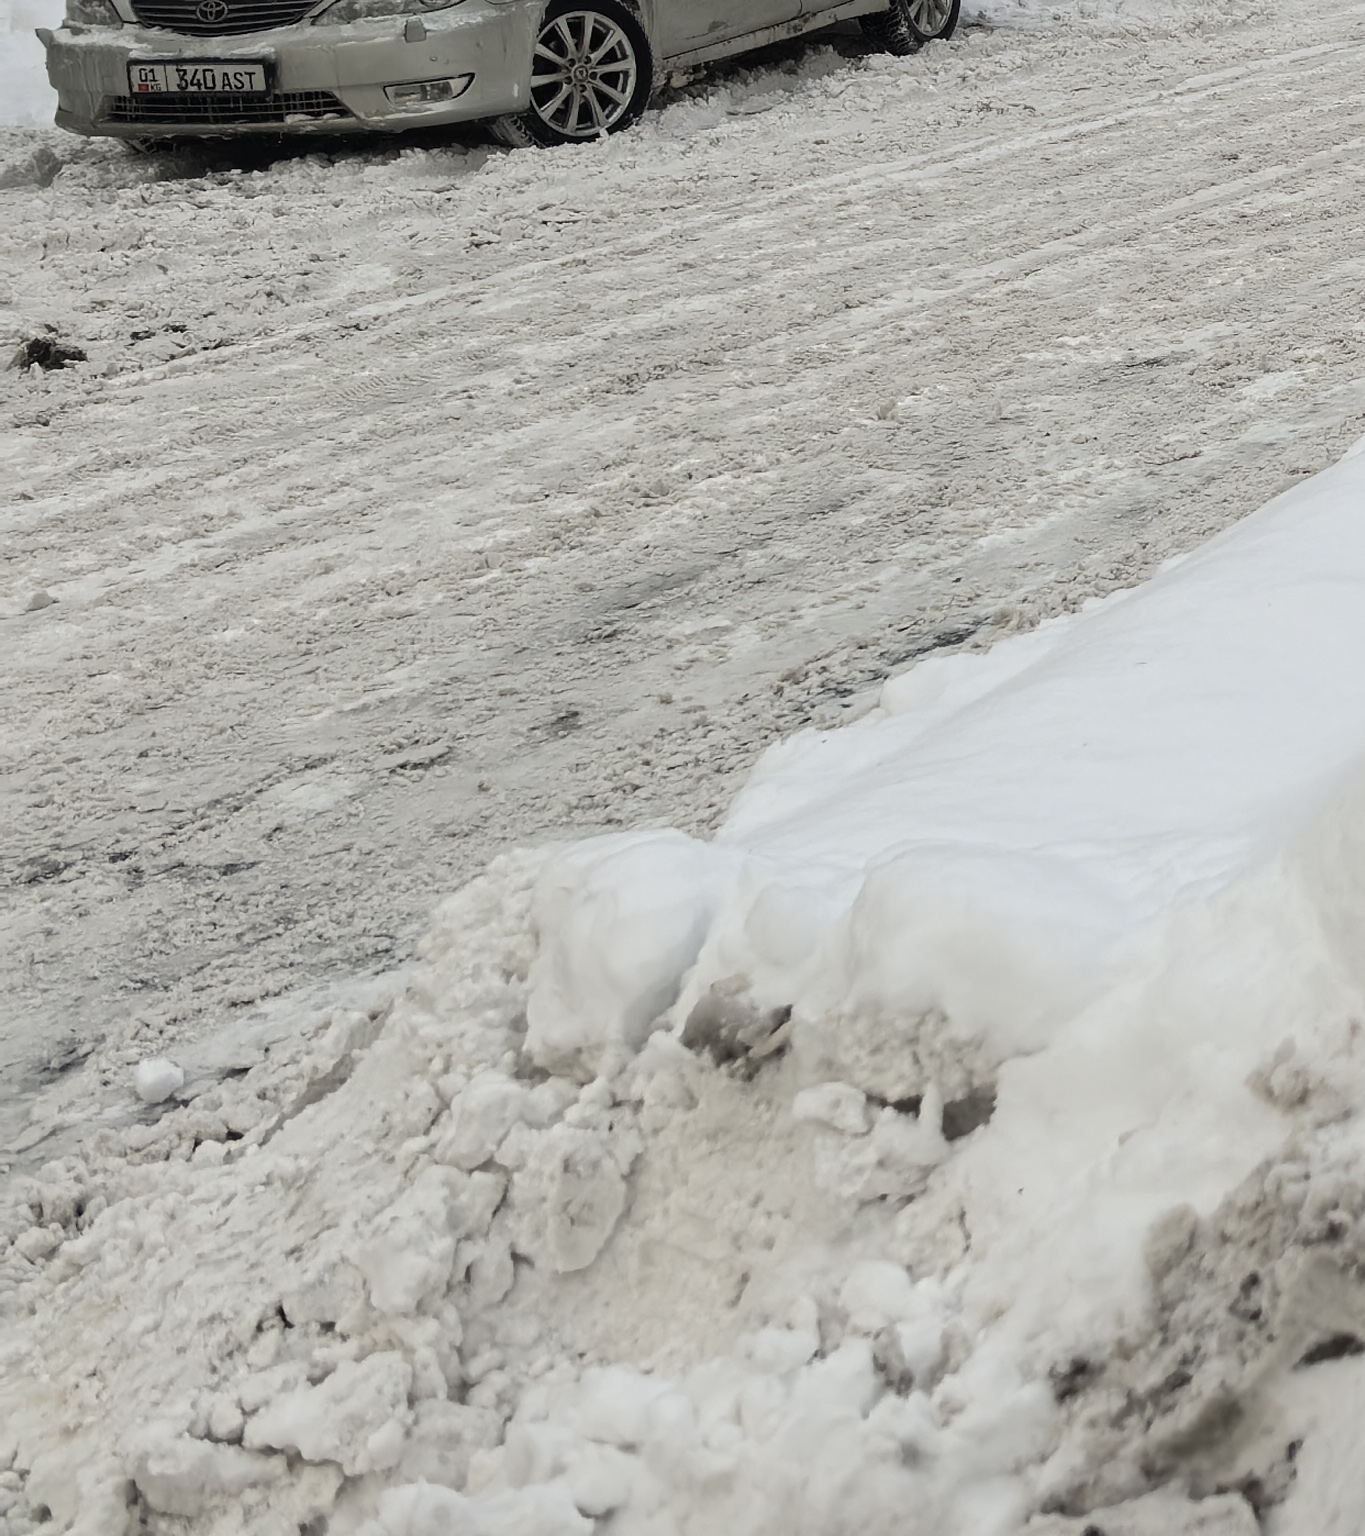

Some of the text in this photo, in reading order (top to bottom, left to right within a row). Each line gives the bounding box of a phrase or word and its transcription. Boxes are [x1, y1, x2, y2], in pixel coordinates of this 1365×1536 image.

[138, 68, 256, 91] 01 340 AST
